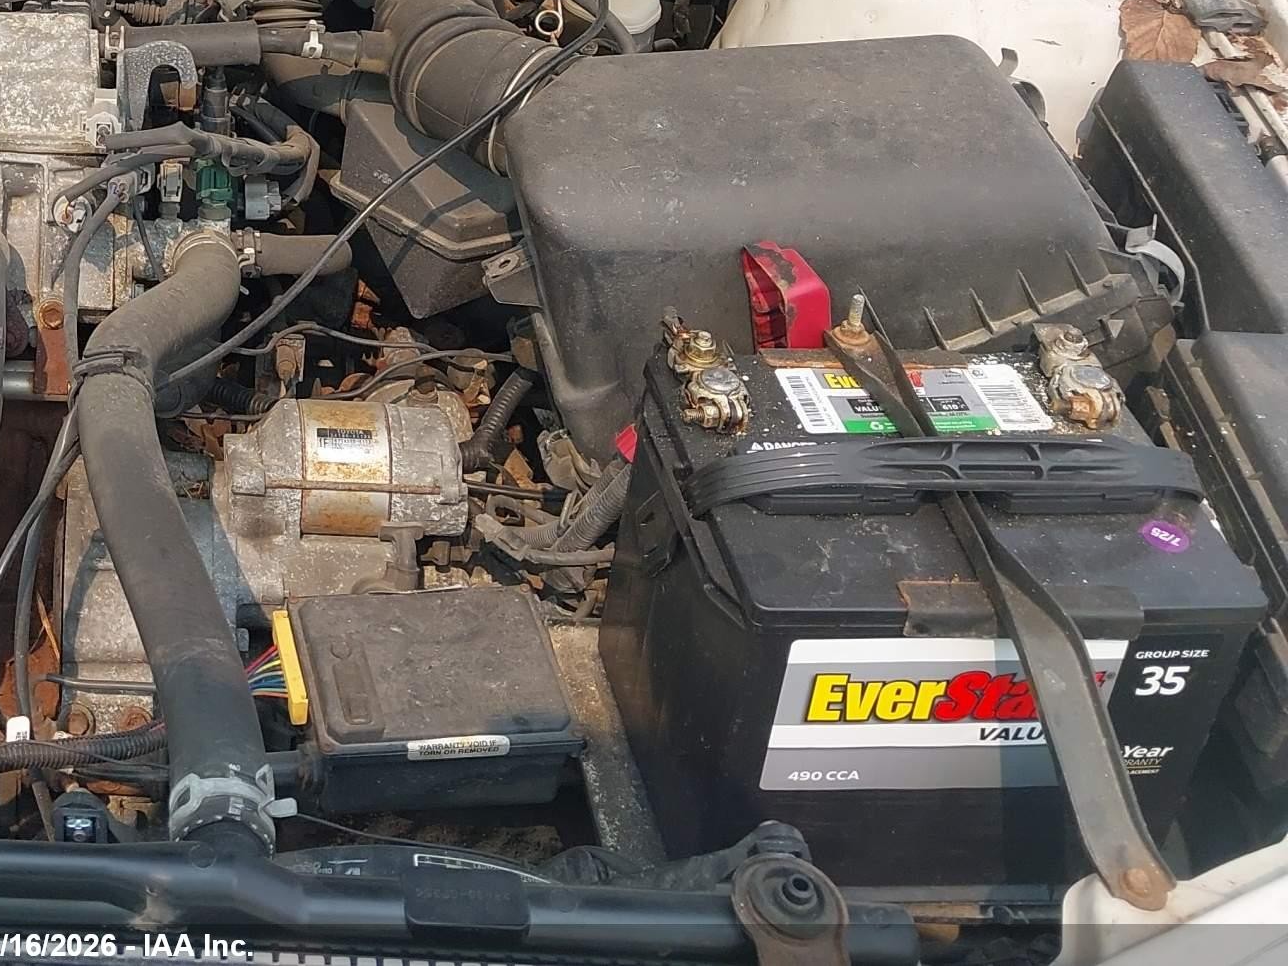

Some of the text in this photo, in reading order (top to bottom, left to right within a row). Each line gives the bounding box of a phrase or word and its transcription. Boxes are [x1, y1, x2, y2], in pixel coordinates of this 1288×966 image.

[1150, 527, 1181, 547] 7/25
[1135, 649, 1210, 659] GROUP SIZE
[1135, 665, 1191, 696] 35
[806, 671, 1106, 723] EverSta
[978, 727, 1043, 741] VALU
[458, 746, 499, 754] REMOVED
[787, 770, 860, 782] 490 CCA
